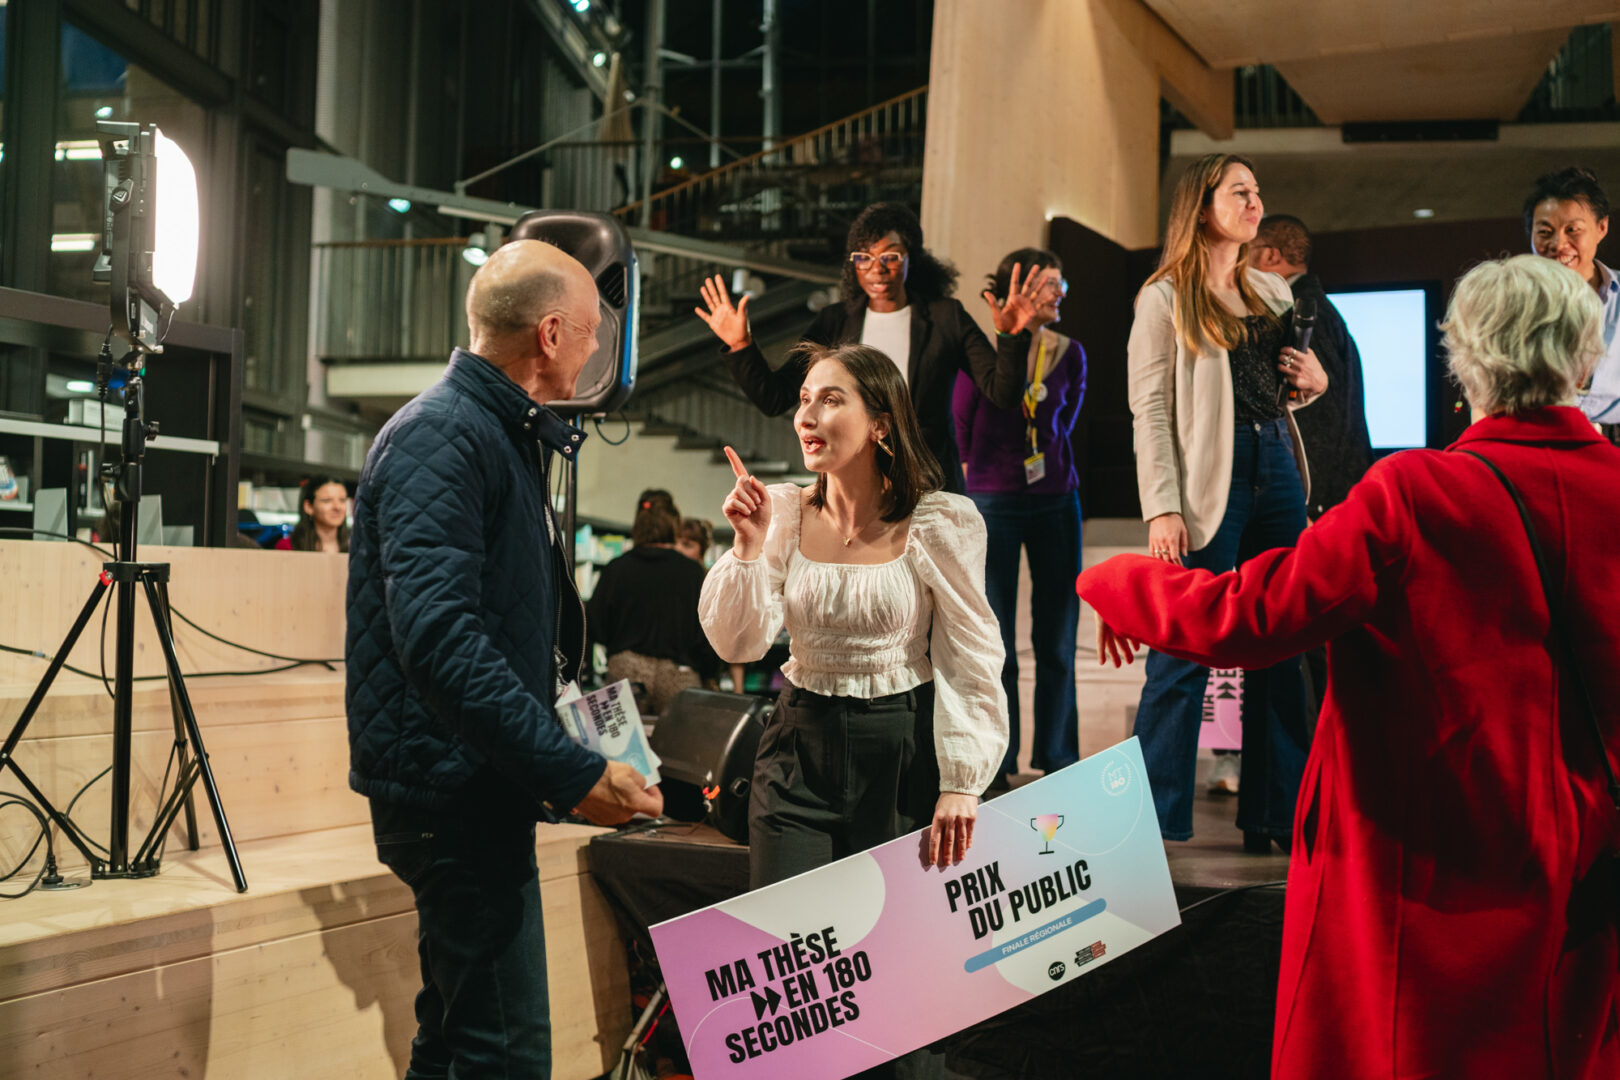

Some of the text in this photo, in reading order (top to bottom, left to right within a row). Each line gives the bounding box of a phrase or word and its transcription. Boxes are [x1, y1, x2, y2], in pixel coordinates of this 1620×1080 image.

[586, 694, 608, 736] SECONDES
[606, 686, 619, 702] MA
[603, 710, 621, 739] EN 180
[944, 860, 1006, 913] PRIX
[968, 859, 1092, 940] DU PUBLIC
[1001, 917, 1073, 955] FINALE RÉGIONALE
[705, 926, 841, 1002] MA THÈSE
[782, 950, 872, 1009] EN 180
[1049, 963, 1065, 977] cnrs
[725, 990, 860, 1064] SECONDES
